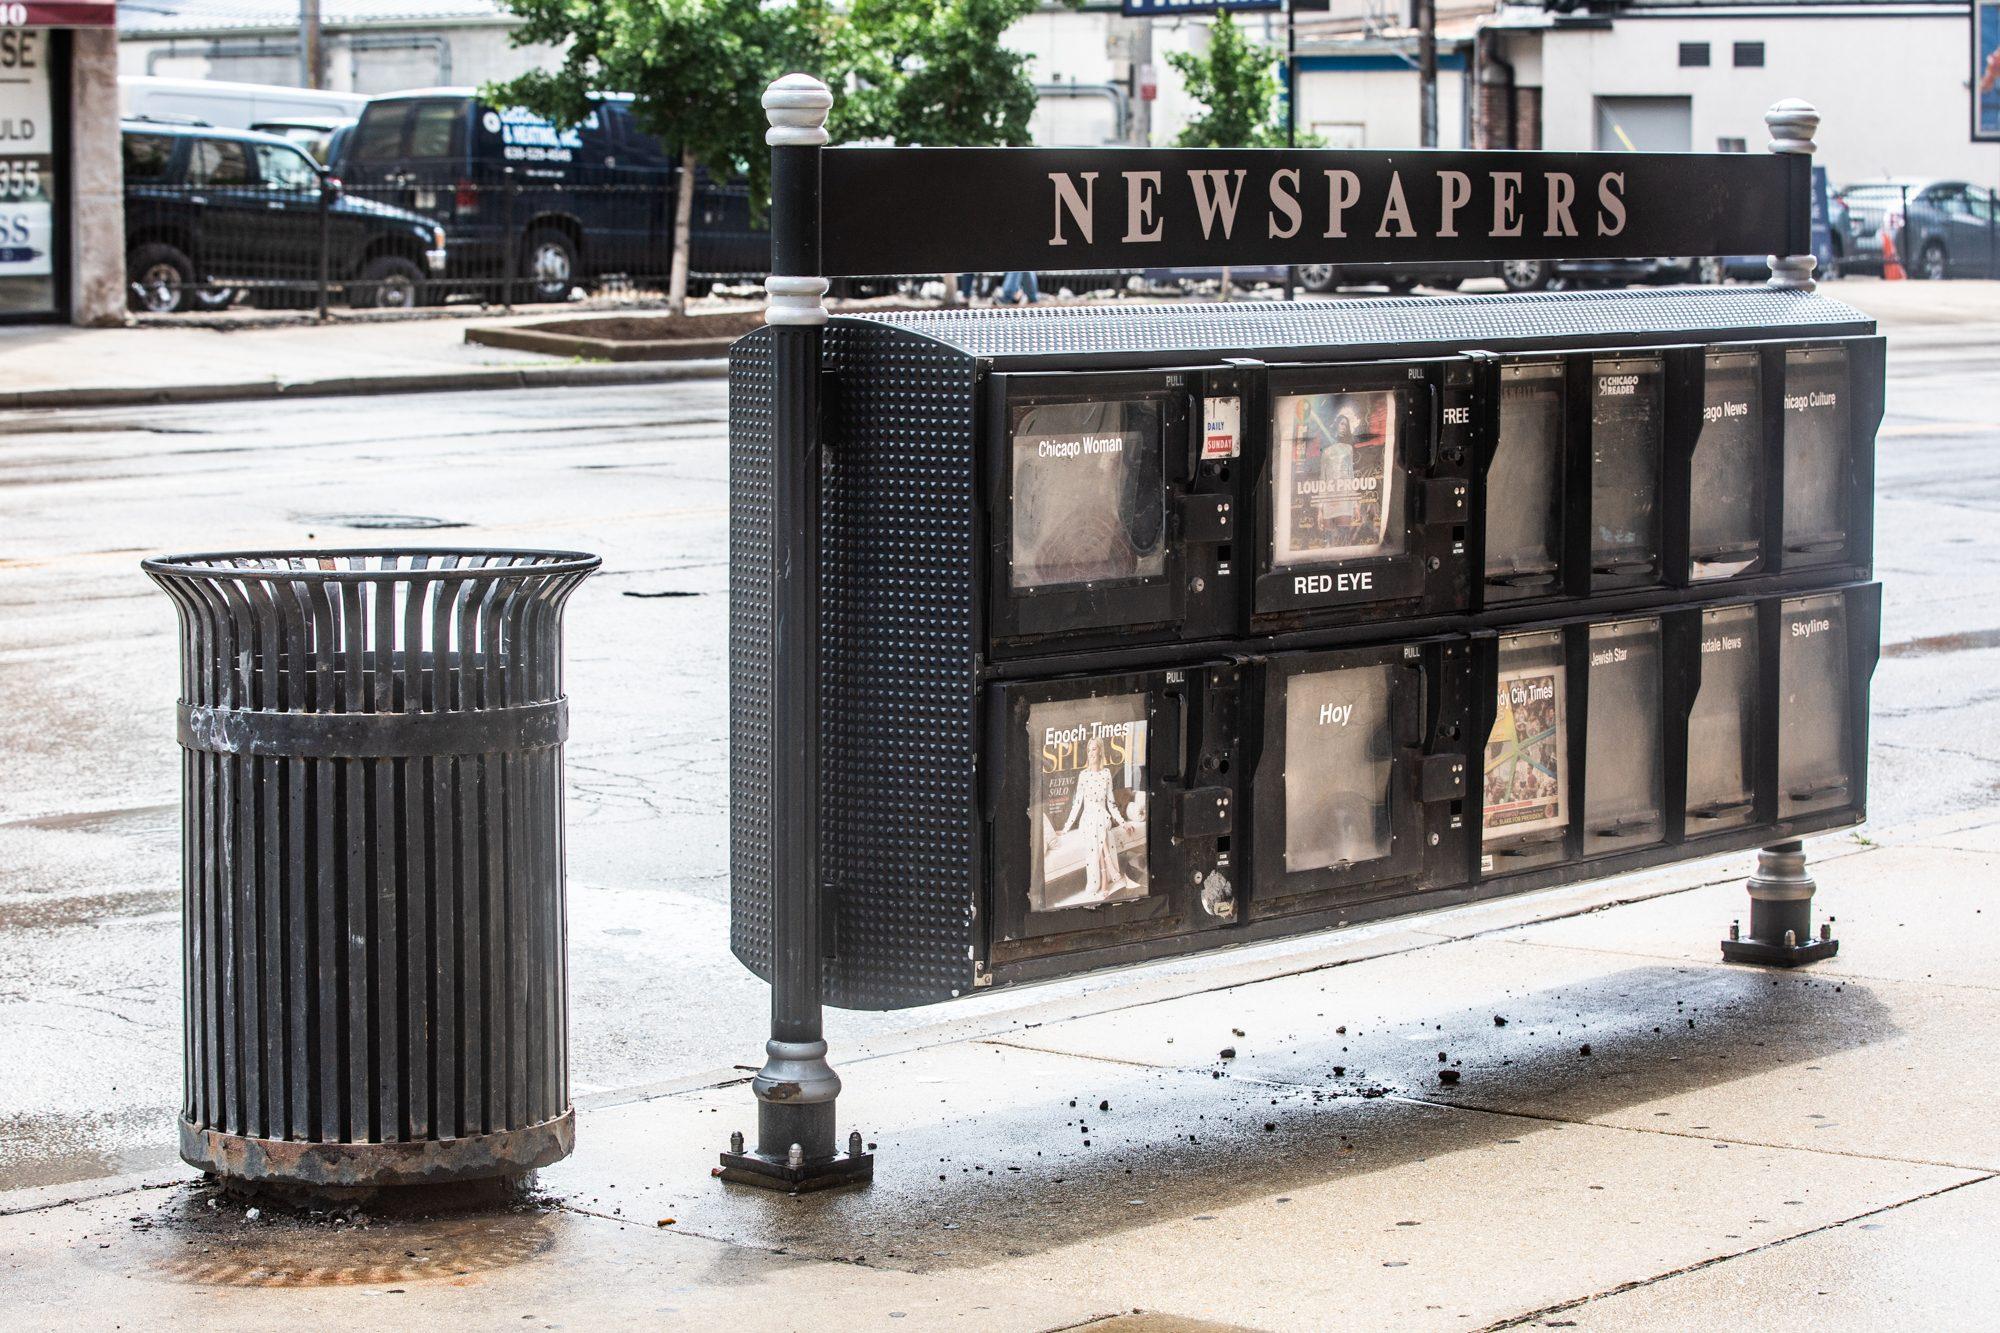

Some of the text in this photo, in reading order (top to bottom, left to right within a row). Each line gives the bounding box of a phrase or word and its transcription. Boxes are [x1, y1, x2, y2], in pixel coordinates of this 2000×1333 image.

[1048, 168, 1627, 246] NEWSPAPERS
[1165, 375, 1184, 387] PULL
[1408, 368, 1424, 380] PULL
[1607, 375, 1639, 386] CHICAGO
[1607, 385, 1635, 395] READER
[1809, 391, 1836, 407] Culture
[1443, 407, 1470, 425] FREE
[1723, 402, 1748, 417] News
[1207, 421, 1225, 431] DAILY
[1038, 436, 1123, 459] Chicago Woman
[1208, 439, 1232, 450] SUNDAY
[1294, 572, 1373, 594] RED EYE
[1792, 618, 1830, 638] Skyline
[1722, 636, 1742, 650] News
[1403, 646, 1420, 659] PULL
[1591, 647, 1628, 667] Jewish Star
[1166, 671, 1184, 684] PULL
[1511, 687, 1527, 706] City
[1529, 684, 1553, 700] Times
[1319, 702, 1352, 727] Hoy
[1045, 721, 1130, 749] Epoch Times
